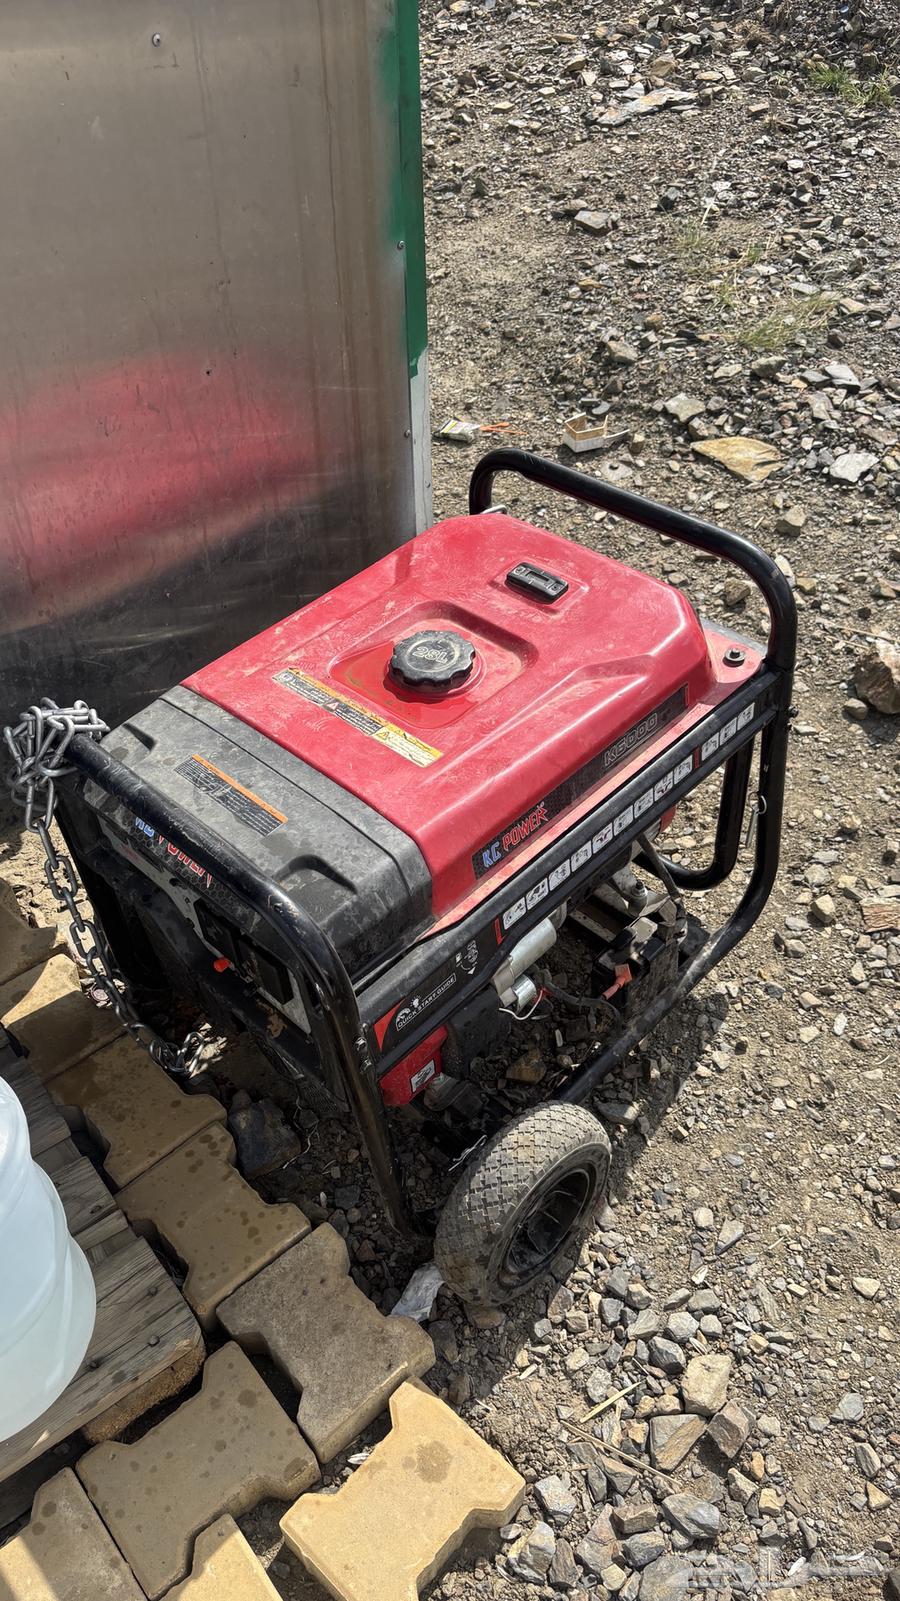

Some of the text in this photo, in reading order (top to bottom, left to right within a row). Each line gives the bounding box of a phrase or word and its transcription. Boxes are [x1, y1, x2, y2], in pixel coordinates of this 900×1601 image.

[412, 646, 448, 664] 28L
[482, 805, 549, 868] KC POWER
[398, 976, 455, 1028] QUICK START GUIDE
